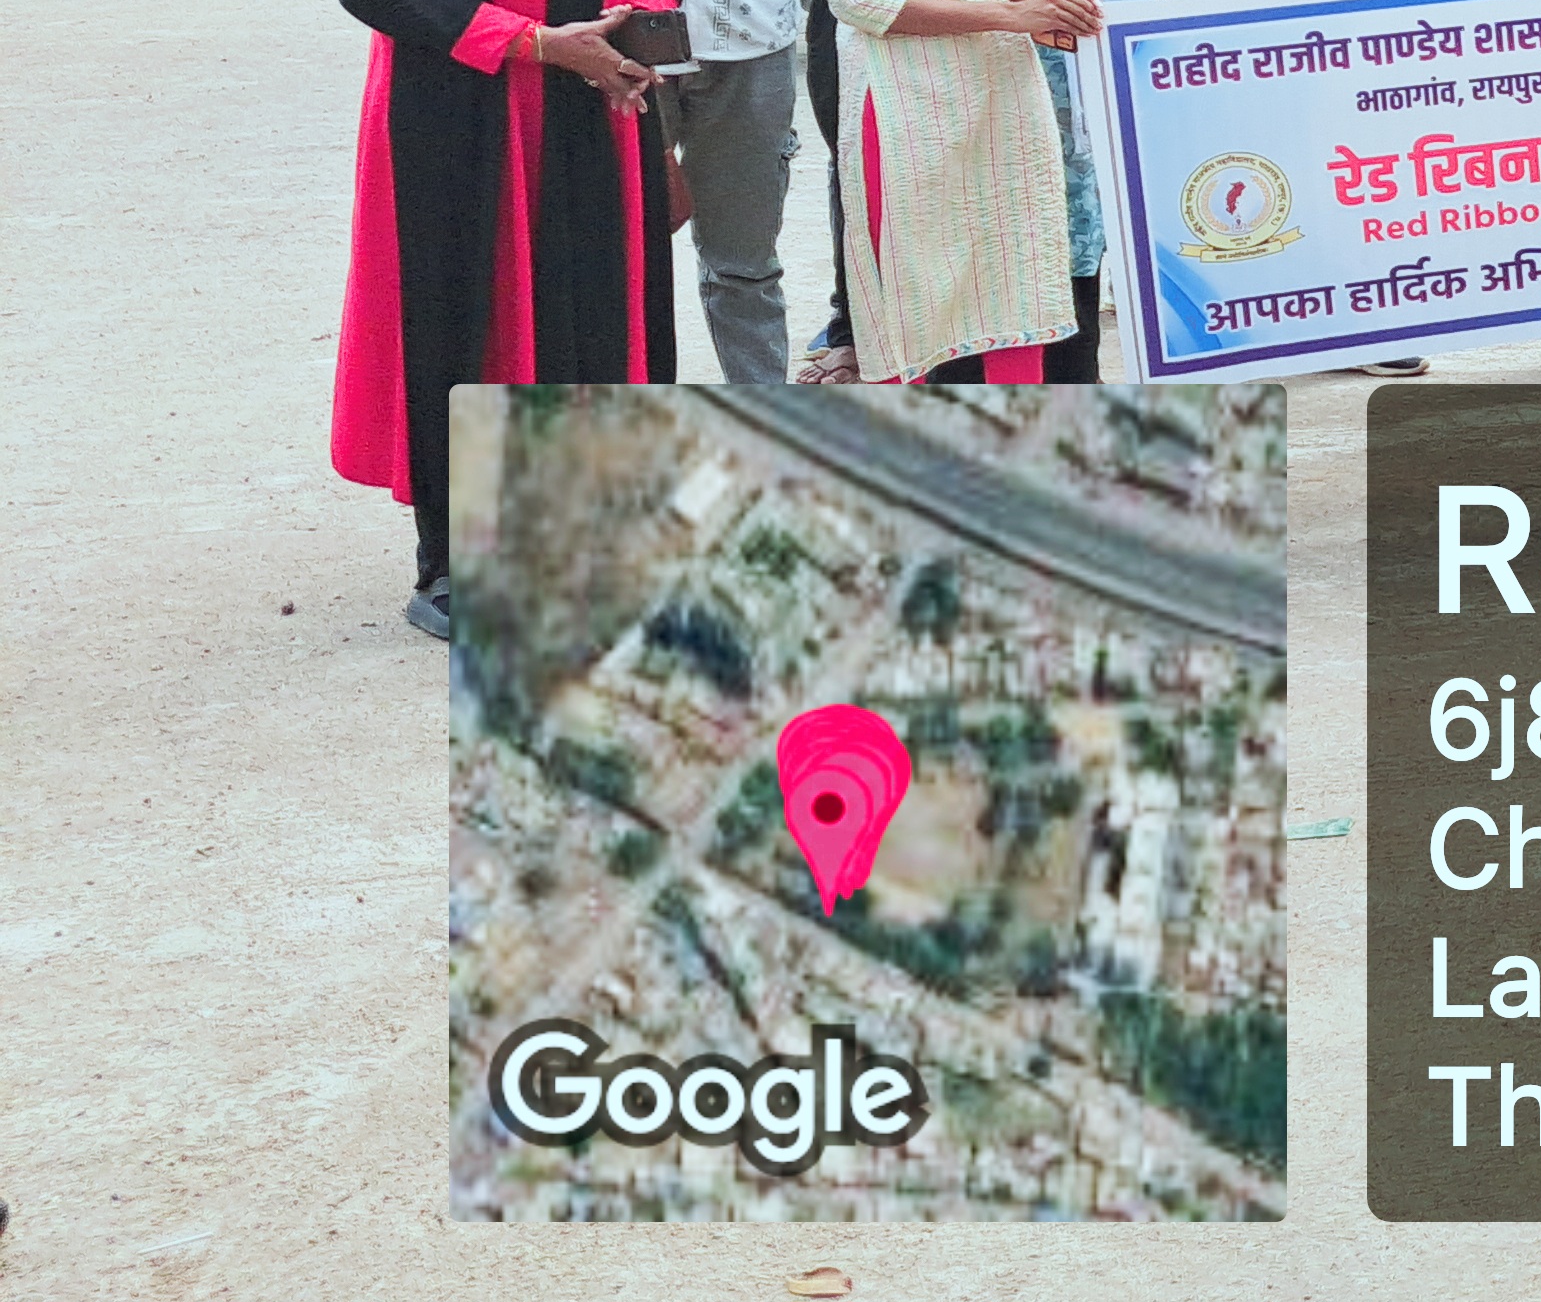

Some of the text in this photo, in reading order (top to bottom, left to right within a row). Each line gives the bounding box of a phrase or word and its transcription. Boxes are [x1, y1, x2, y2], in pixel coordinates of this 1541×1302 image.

[1150, 42, 1243, 90] शहीद
[1247, 30, 1351, 78] राजीव
[1357, 19, 1465, 66] पाण्डेय
[1356, 75, 1465, 113] भाठागांव,
[1326, 143, 1400, 206] रेड
[1362, 210, 1429, 244] Red
[1205, 285, 1336, 332] आपका
[1344, 256, 1469, 314] हार्दिक
